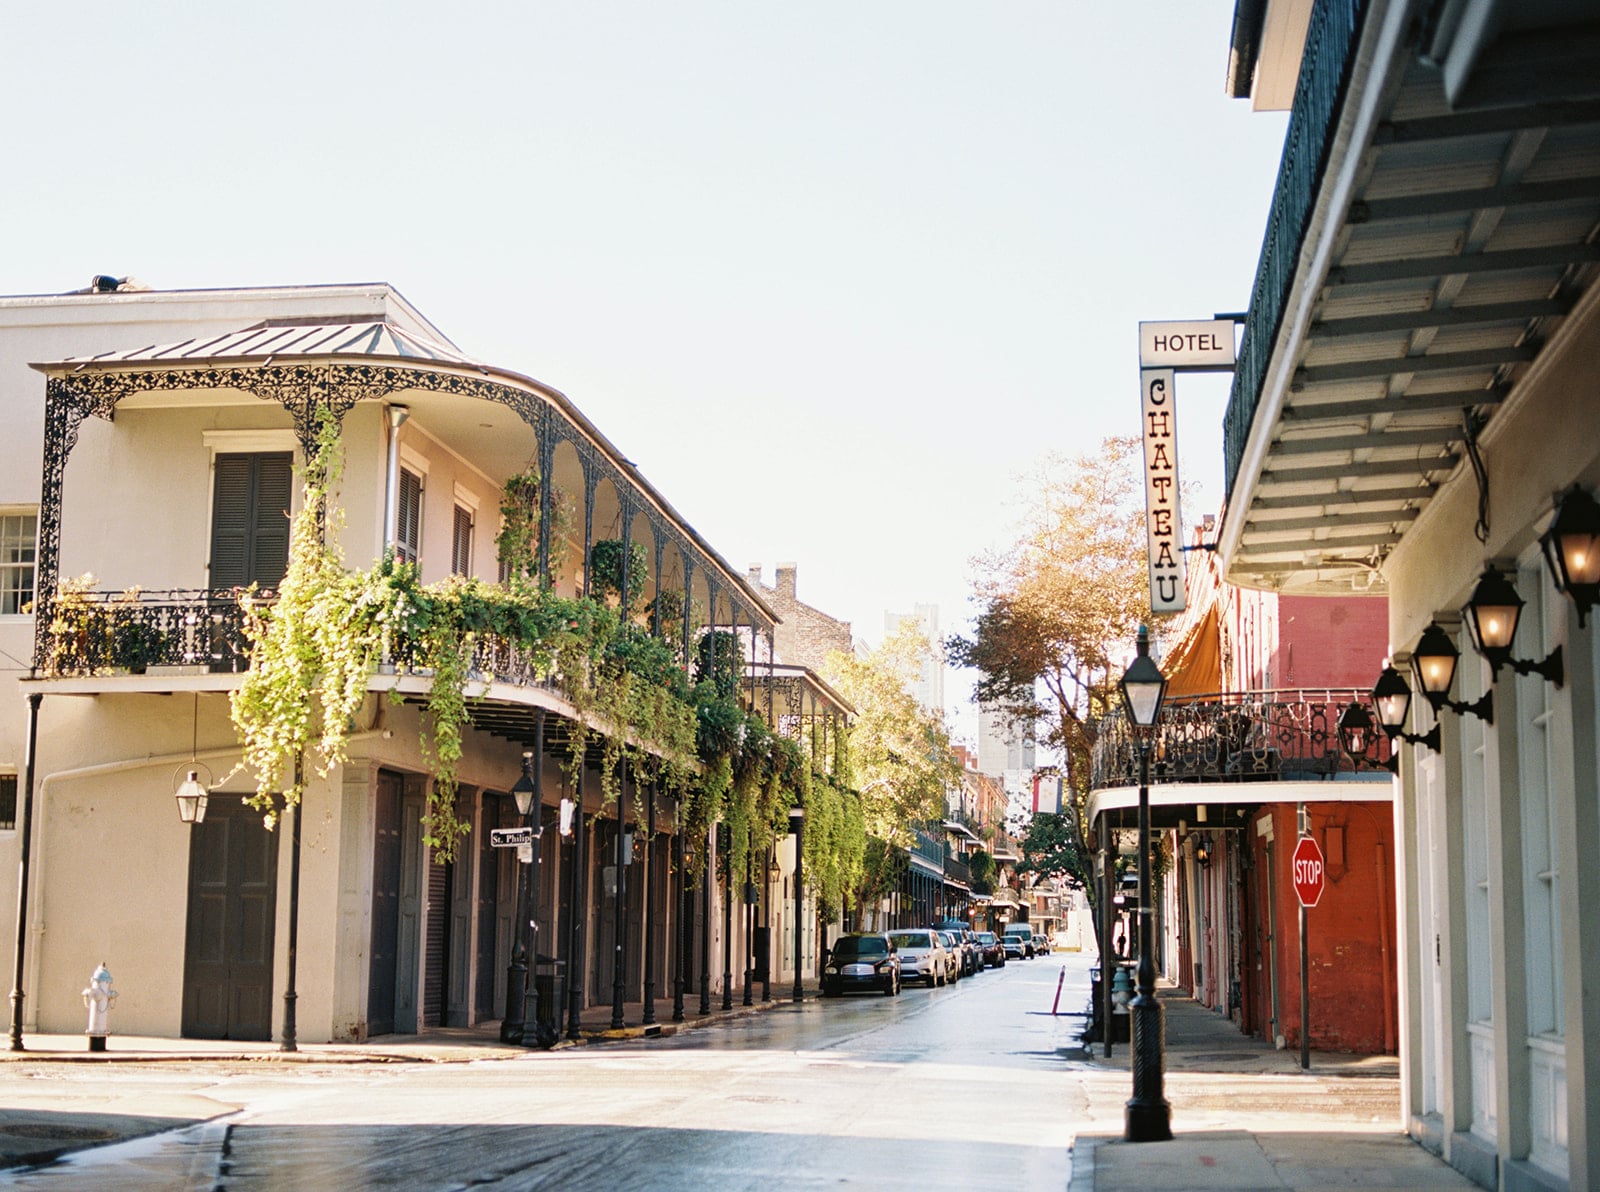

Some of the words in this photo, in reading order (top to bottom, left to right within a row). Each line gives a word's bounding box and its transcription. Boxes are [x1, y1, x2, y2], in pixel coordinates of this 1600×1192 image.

[1153, 334, 1223, 352] HOTEL
[1148, 378, 1178, 603] CHATEAU
[492, 834, 504, 844] St.
[506, 833, 531, 844] Philip
[1296, 859, 1321, 885] STOP
